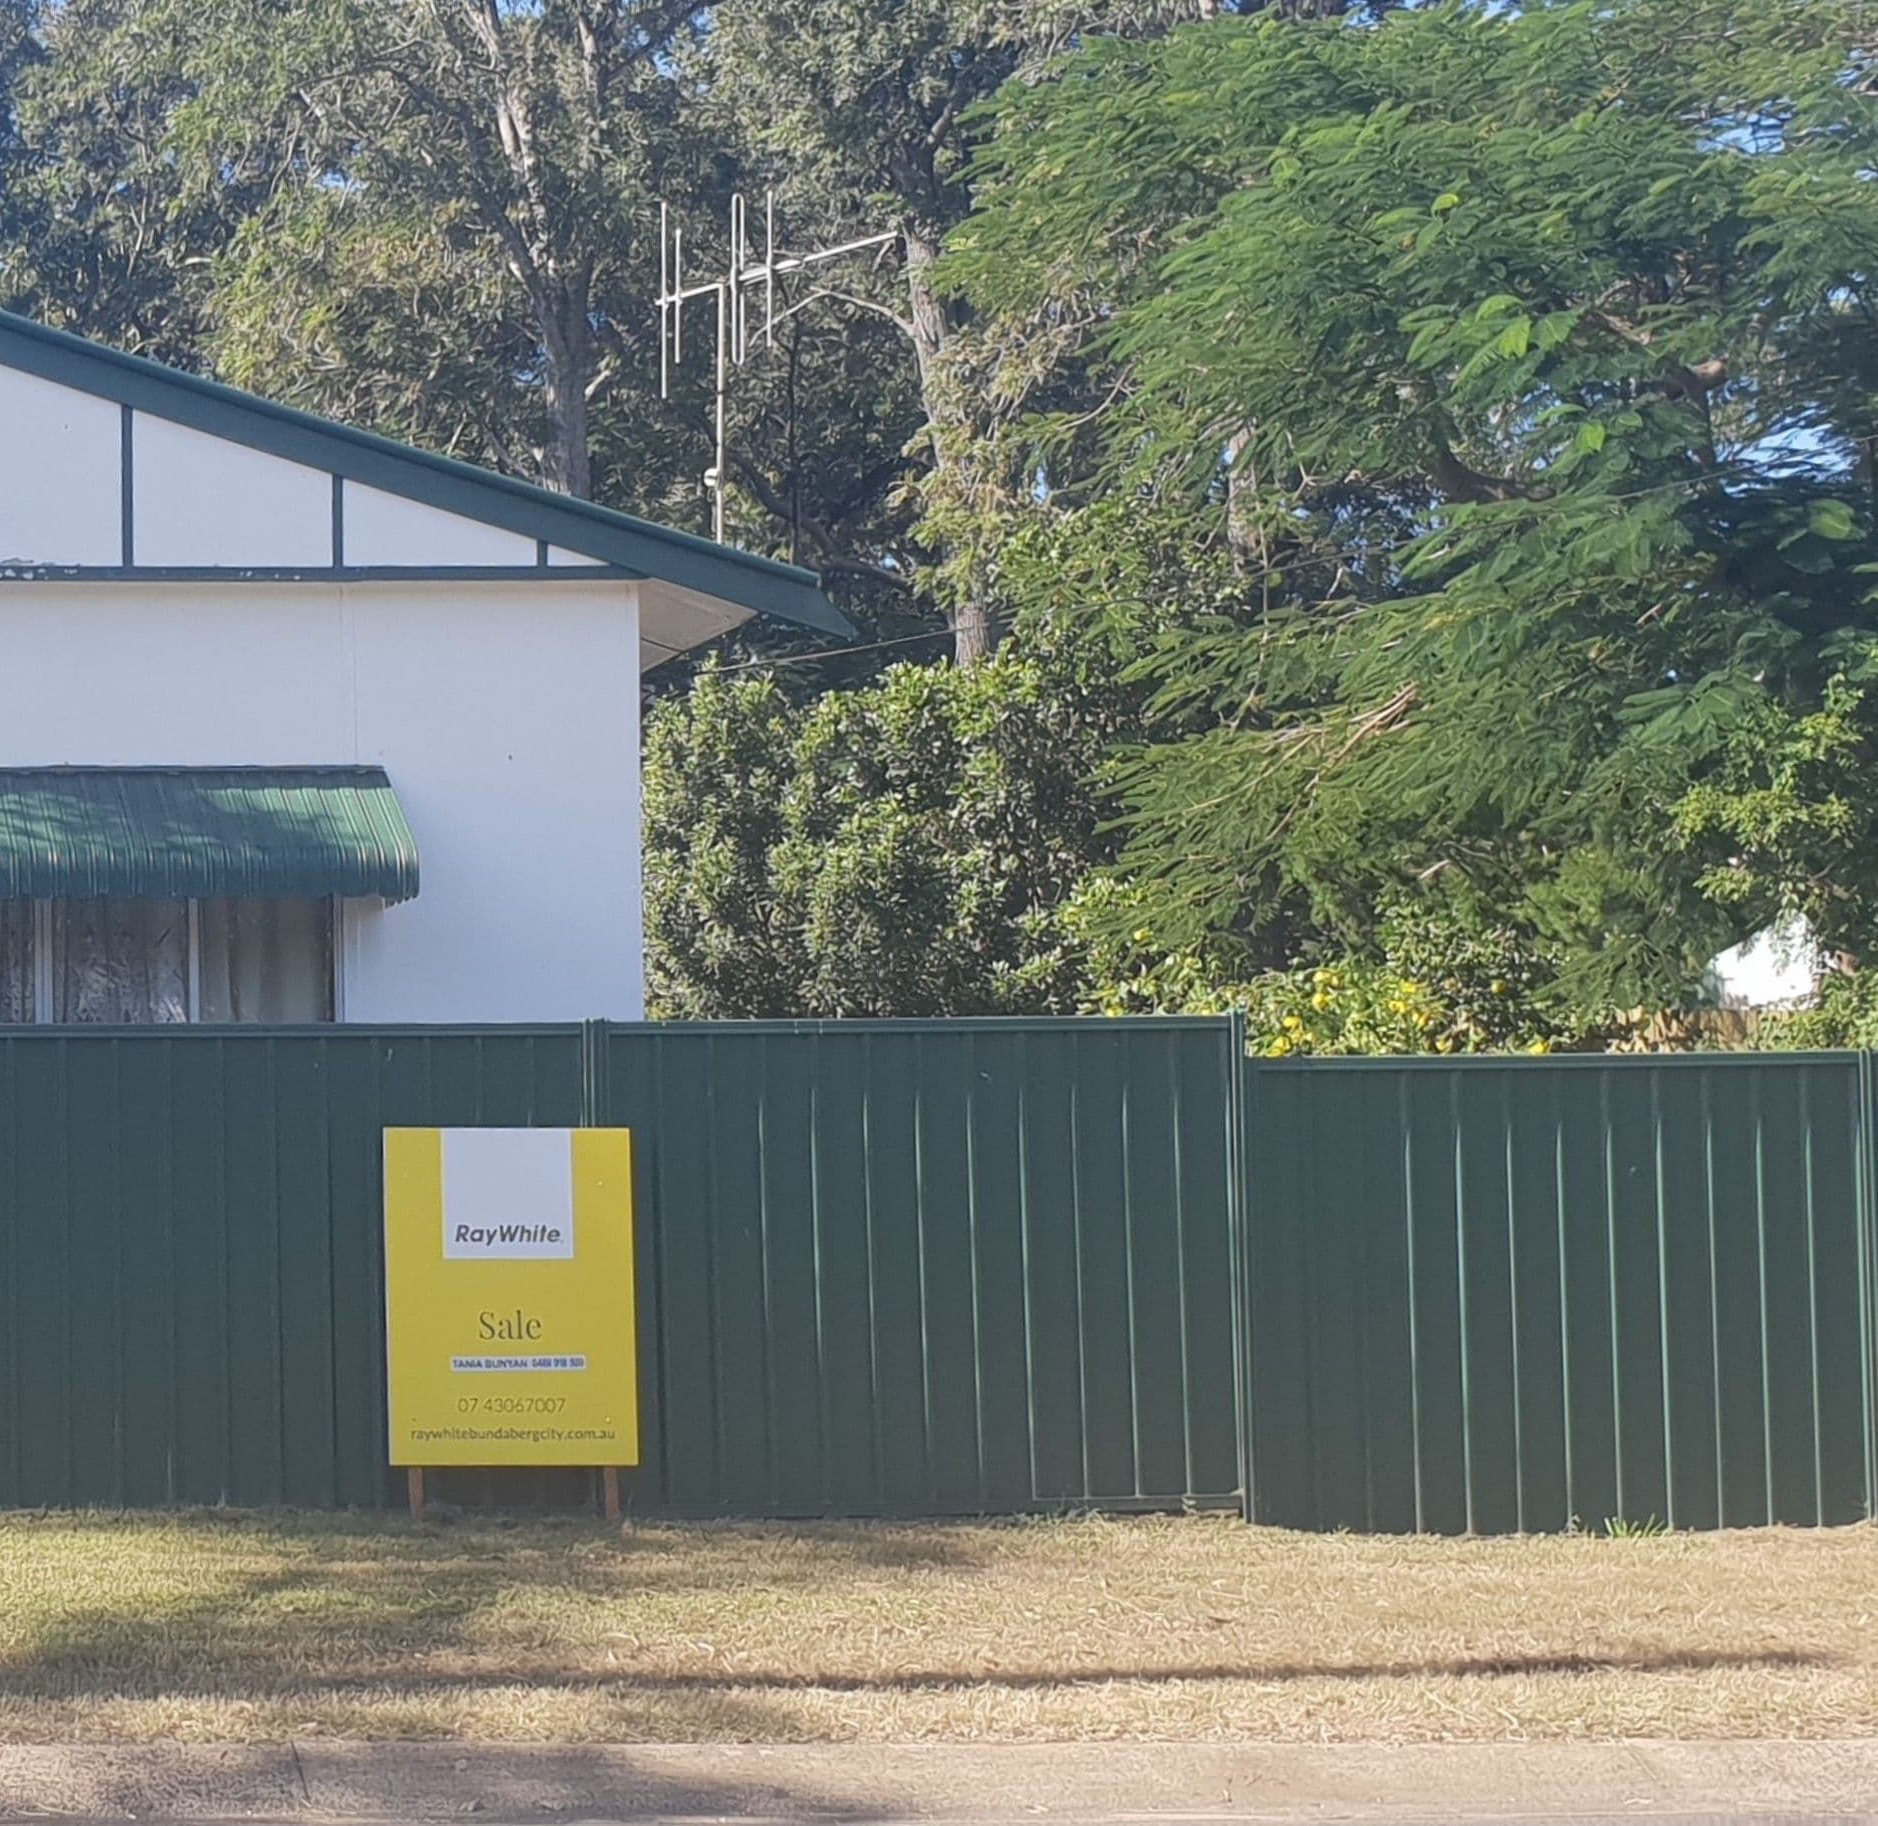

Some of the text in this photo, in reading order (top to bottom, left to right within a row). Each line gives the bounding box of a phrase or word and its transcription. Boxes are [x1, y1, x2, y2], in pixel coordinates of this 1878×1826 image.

[478, 1309, 542, 1341] Sale
[453, 1359, 483, 1369] TANIA
[457, 1397, 566, 1414] 07 43067007
[410, 1427, 616, 1443] raywhitebundabergcity.com.au
